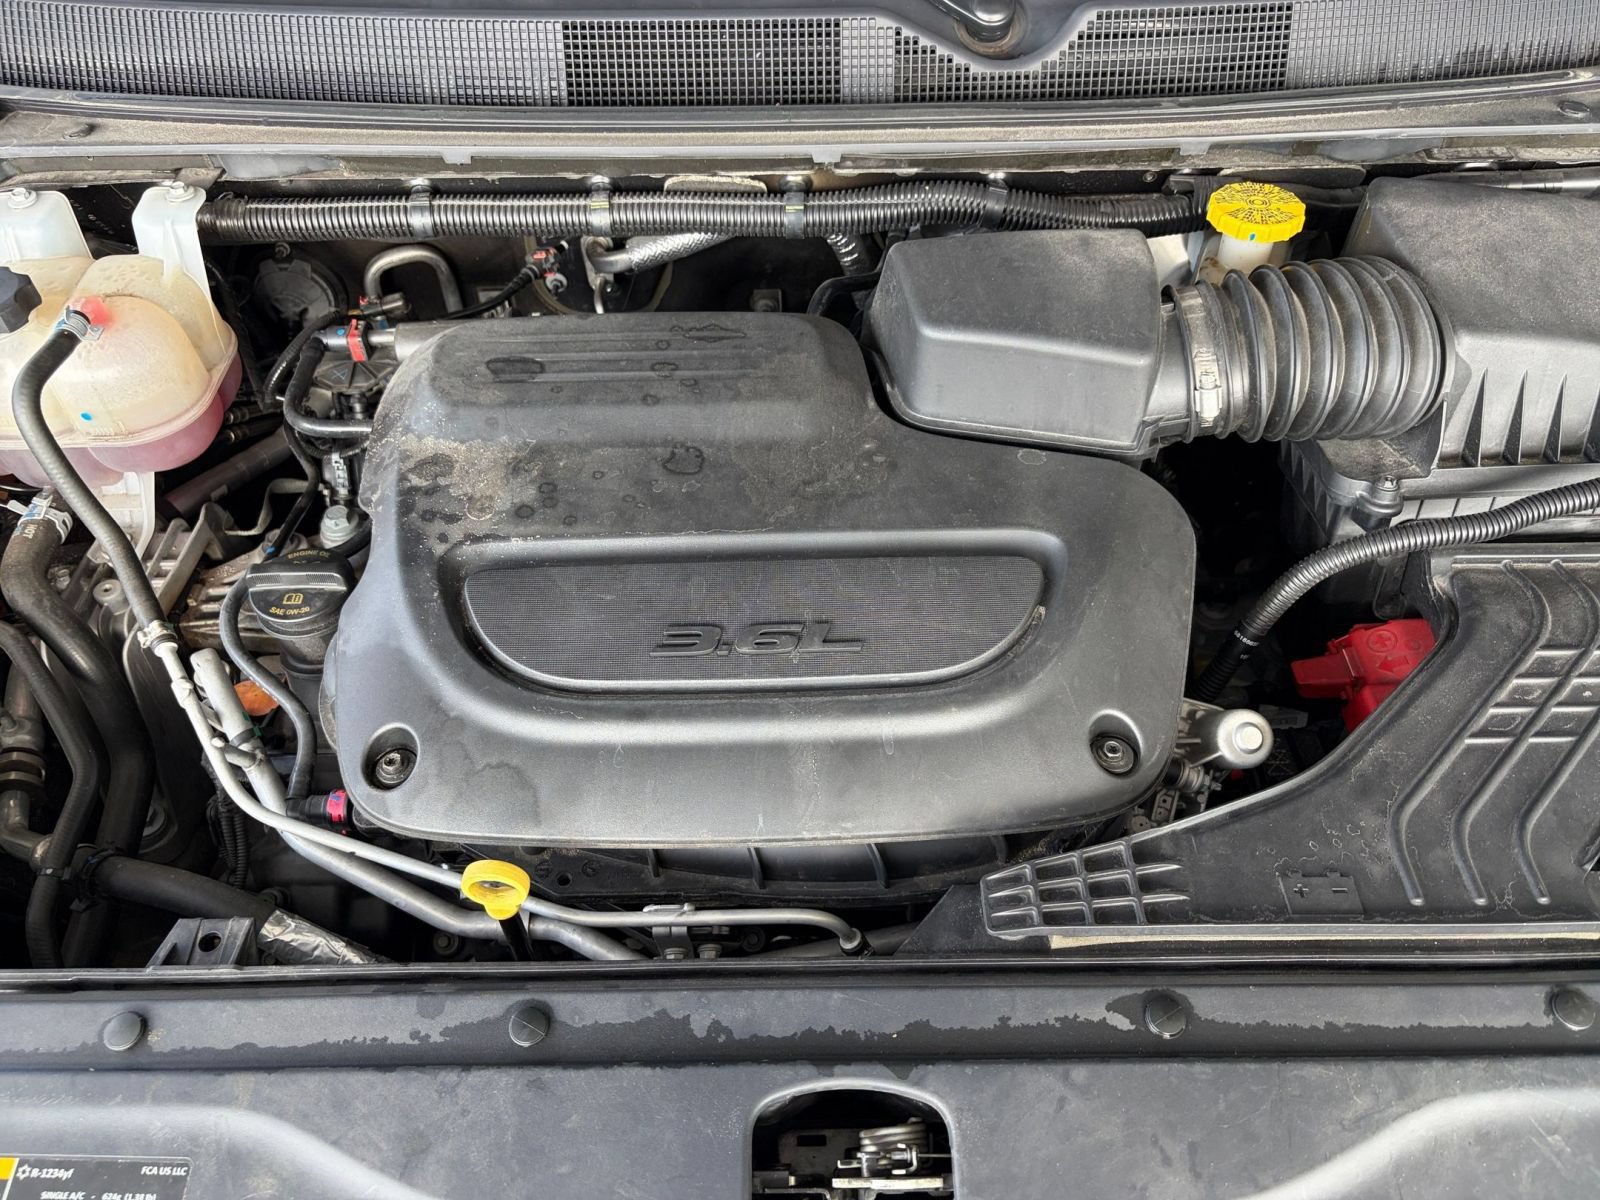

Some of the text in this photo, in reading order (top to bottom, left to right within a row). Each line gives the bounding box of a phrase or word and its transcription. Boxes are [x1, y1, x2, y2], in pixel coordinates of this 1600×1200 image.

[287, 550, 319, 559] ENGINE
[269, 606, 310, 616] SAE 0W-20
[650, 621, 864, 656] 3.6L
[30, 1167, 75, 1181] R-1234yf
[140, 1165, 188, 1176] FCA US LLC
[40, 1190, 70, 1200] SINGLE
[69, 1190, 86, 1200] A/C
